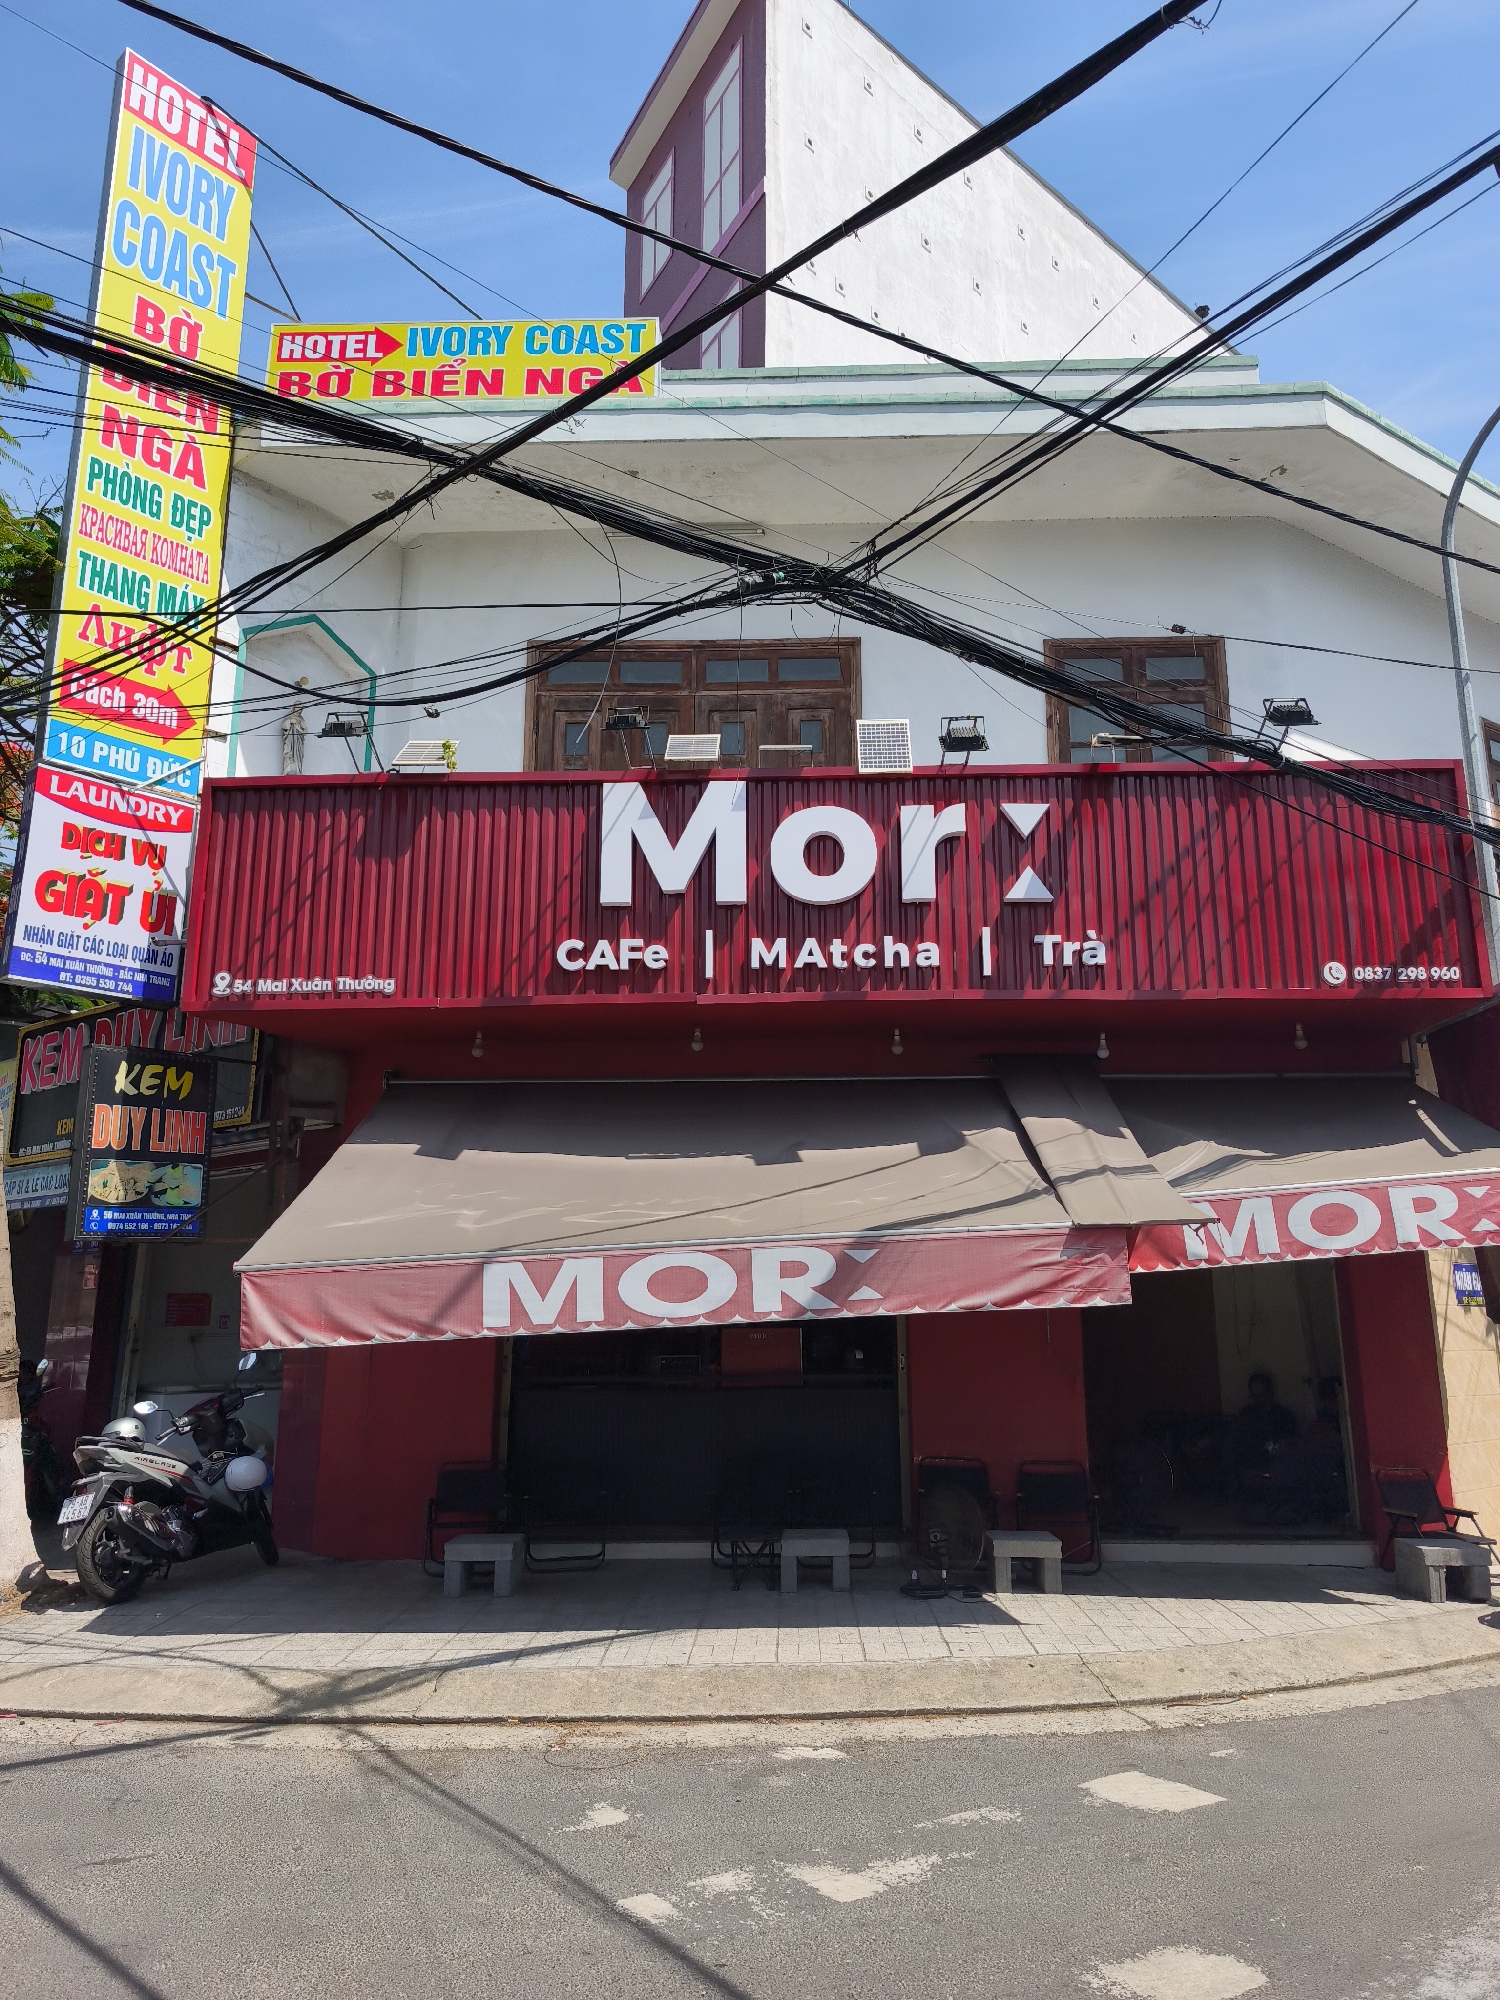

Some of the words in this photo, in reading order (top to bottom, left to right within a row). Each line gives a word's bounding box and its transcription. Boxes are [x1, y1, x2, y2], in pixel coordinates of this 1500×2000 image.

[129, 62, 245, 179] HOTEL
[128, 125, 236, 243] IVORY
[112, 198, 237, 320] COAST
[134, 296, 204, 361] BỜ
[281, 333, 384, 359] HOTEL
[407, 326, 512, 356] IVORY
[525, 323, 646, 355] COAST
[277, 364, 355, 398] BỜ
[371, 359, 504, 397] BIỂN
[525, 360, 644, 396] NGÀ
[101, 404, 208, 491] NGÀ
[87, 456, 163, 521] PHÒNG
[170, 493, 212, 541] ĐẸP
[79, 503, 149, 561] КРАСИВАЯ
[150, 532, 209, 585] КОМНАТА
[78, 550, 151, 612] THANG
[70, 673, 127, 713] Cách
[132, 692, 178, 729] 30m
[58, 732, 86, 759] 10
[92, 743, 142, 773] PHÚ
[50, 775, 185, 826] LAUNDRY
[61, 821, 127, 861] DỊCH
[131, 838, 168, 876] VỤ
[600, 780, 965, 906] Mor
[34, 867, 134, 931] GIẶT
[23, 924, 55, 949] NHẬN
[82, 935, 105, 956] CÁC
[106, 940, 130, 962] LOẠI
[160, 948, 174, 968] ÁO
[34, 951, 48, 965] 54
[49, 957, 64, 968] MAI
[556, 938, 669, 970] CAFe
[750, 935, 941, 970] MAtcha
[1034, 929, 1107, 967] Trà
[1353, 966, 1392, 980] 0837
[1398, 966, 1427, 980] 298
[1430, 966, 1460, 980] 960
[75, 974, 98, 987] 0355
[99, 978, 115, 990] 530
[117, 982, 133, 992] 744
[233, 979, 252, 992] 54
[290, 977, 332, 992] Xuân
[20, 1023, 90, 1094] KEM
[114, 1060, 194, 1100] KEM
[56, 1117, 75, 1136] KEM
[92, 1104, 147, 1150] DUY
[150, 1108, 208, 1154] LINH
[1182, 1184, 1465, 1260] MOR
[482, 1246, 842, 1328] MOR
